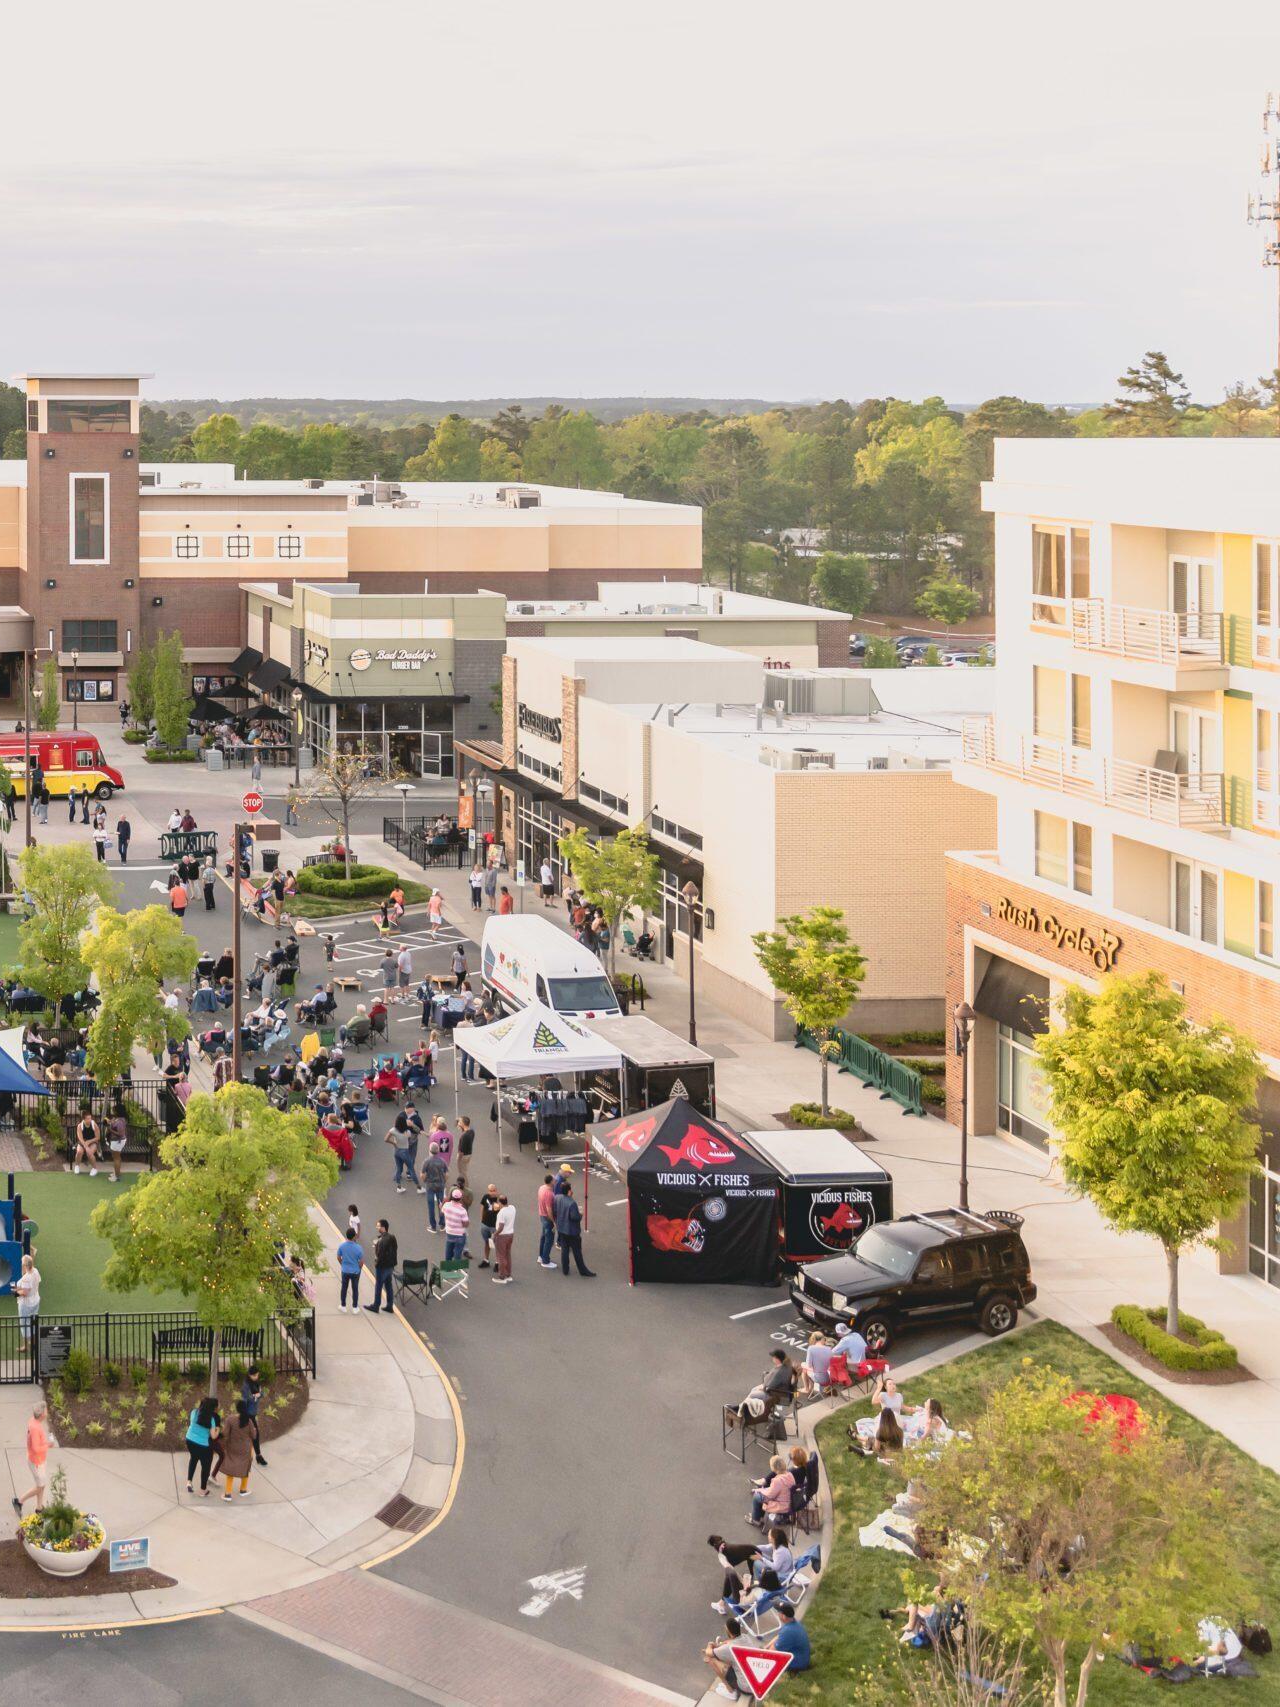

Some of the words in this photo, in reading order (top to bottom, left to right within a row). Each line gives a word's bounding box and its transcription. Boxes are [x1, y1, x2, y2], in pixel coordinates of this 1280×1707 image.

[375, 649, 397, 660] Bad
[397, 649, 438, 662] Daddy's
[243, 798, 262, 807] STOP
[998, 896, 1038, 932] Rush
[1041, 914, 1094, 956] Cycle
[657, 1173, 696, 1186] VICIOUS
[714, 1174, 750, 1187] FISHES
[725, 1189, 747, 1197] VICIOUS
[756, 1189, 776, 1197] FISHES
[811, 1193, 843, 1203] VICIOUS
[844, 1191, 873, 1202] FISHES
[61, 1632, 86, 1640] FIRE
[93, 1629, 122, 1637] LANE
[751, 1660, 771, 1669] YIELD
